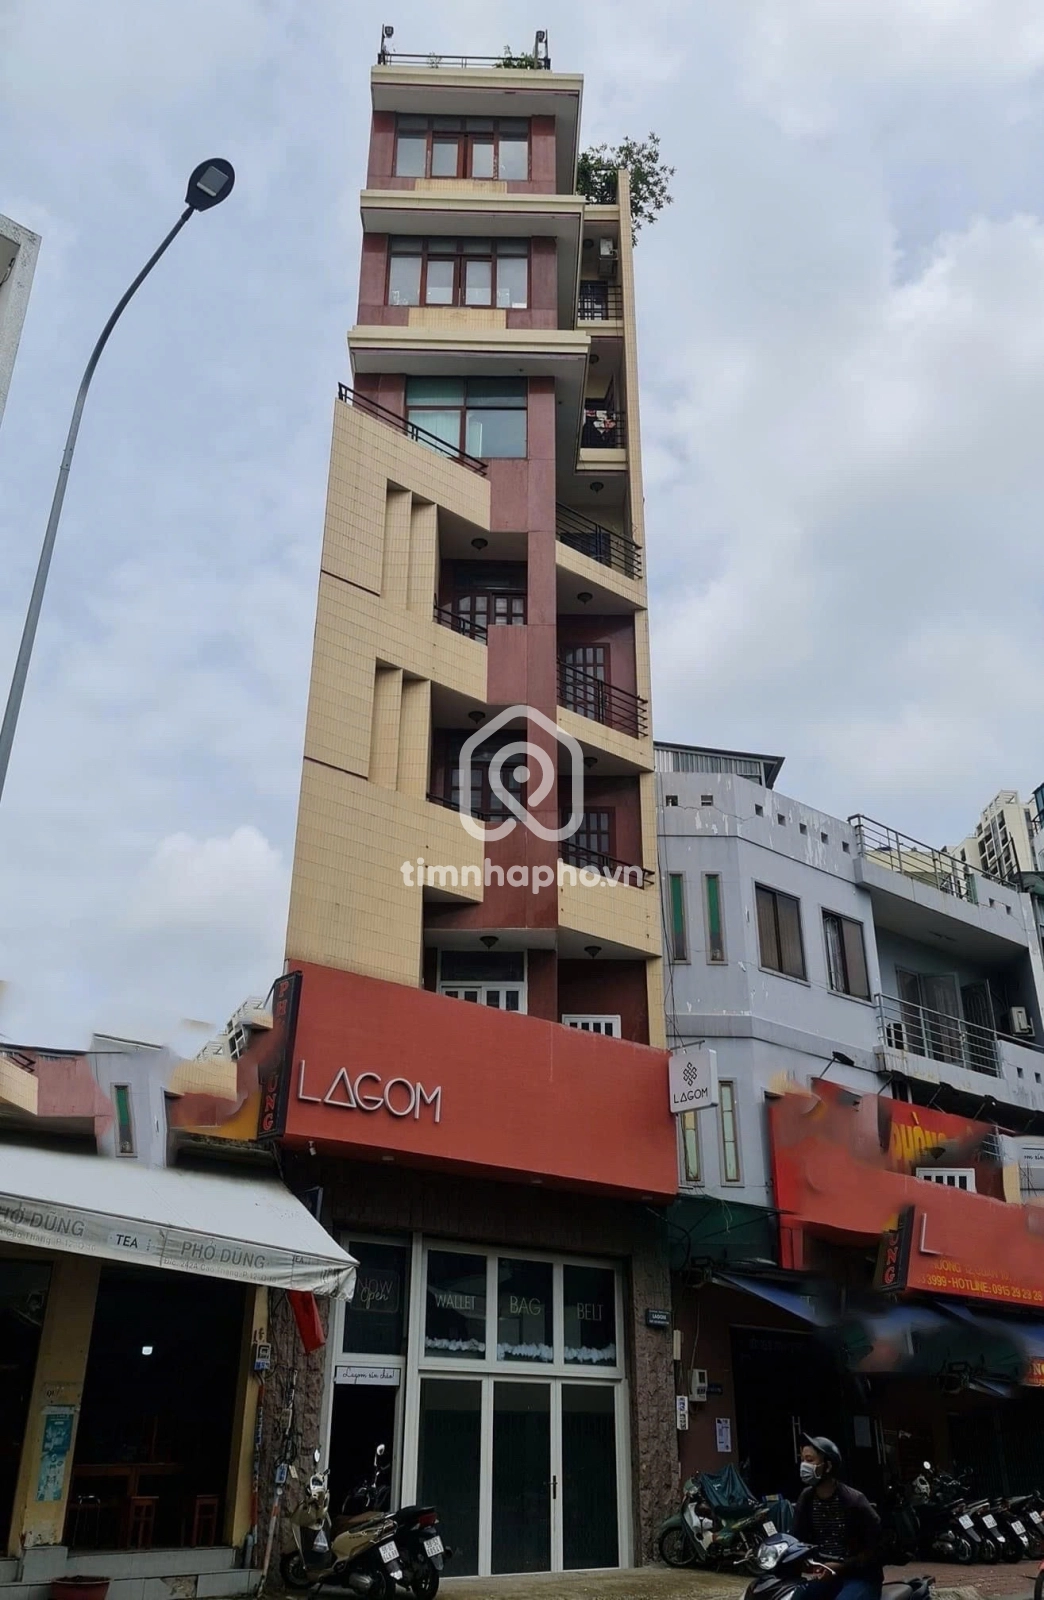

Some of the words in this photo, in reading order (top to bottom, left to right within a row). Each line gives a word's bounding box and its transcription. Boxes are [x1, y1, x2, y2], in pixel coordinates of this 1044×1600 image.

[298, 1060, 441, 1122] LAGOM
[673, 1087, 708, 1104] LAGOM
[30, 1211, 85, 1237] DŨNG
[116, 1234, 138, 1249] TEA
[180, 1238, 217, 1261] PHỞ
[220, 1247, 266, 1270] DŨNG
[201, 1263, 214, 1272] Cao
[357, 1278, 394, 1296] NOW
[927, 1274, 947, 1287] 3999
[951, 1277, 991, 1293] HOTLINE:
[992, 1284, 1010, 1296] 0915
[361, 1287, 388, 1310] Open
[435, 1294, 477, 1311] WALLET
[510, 1295, 541, 1316] BAG
[577, 1302, 604, 1322] BELT
